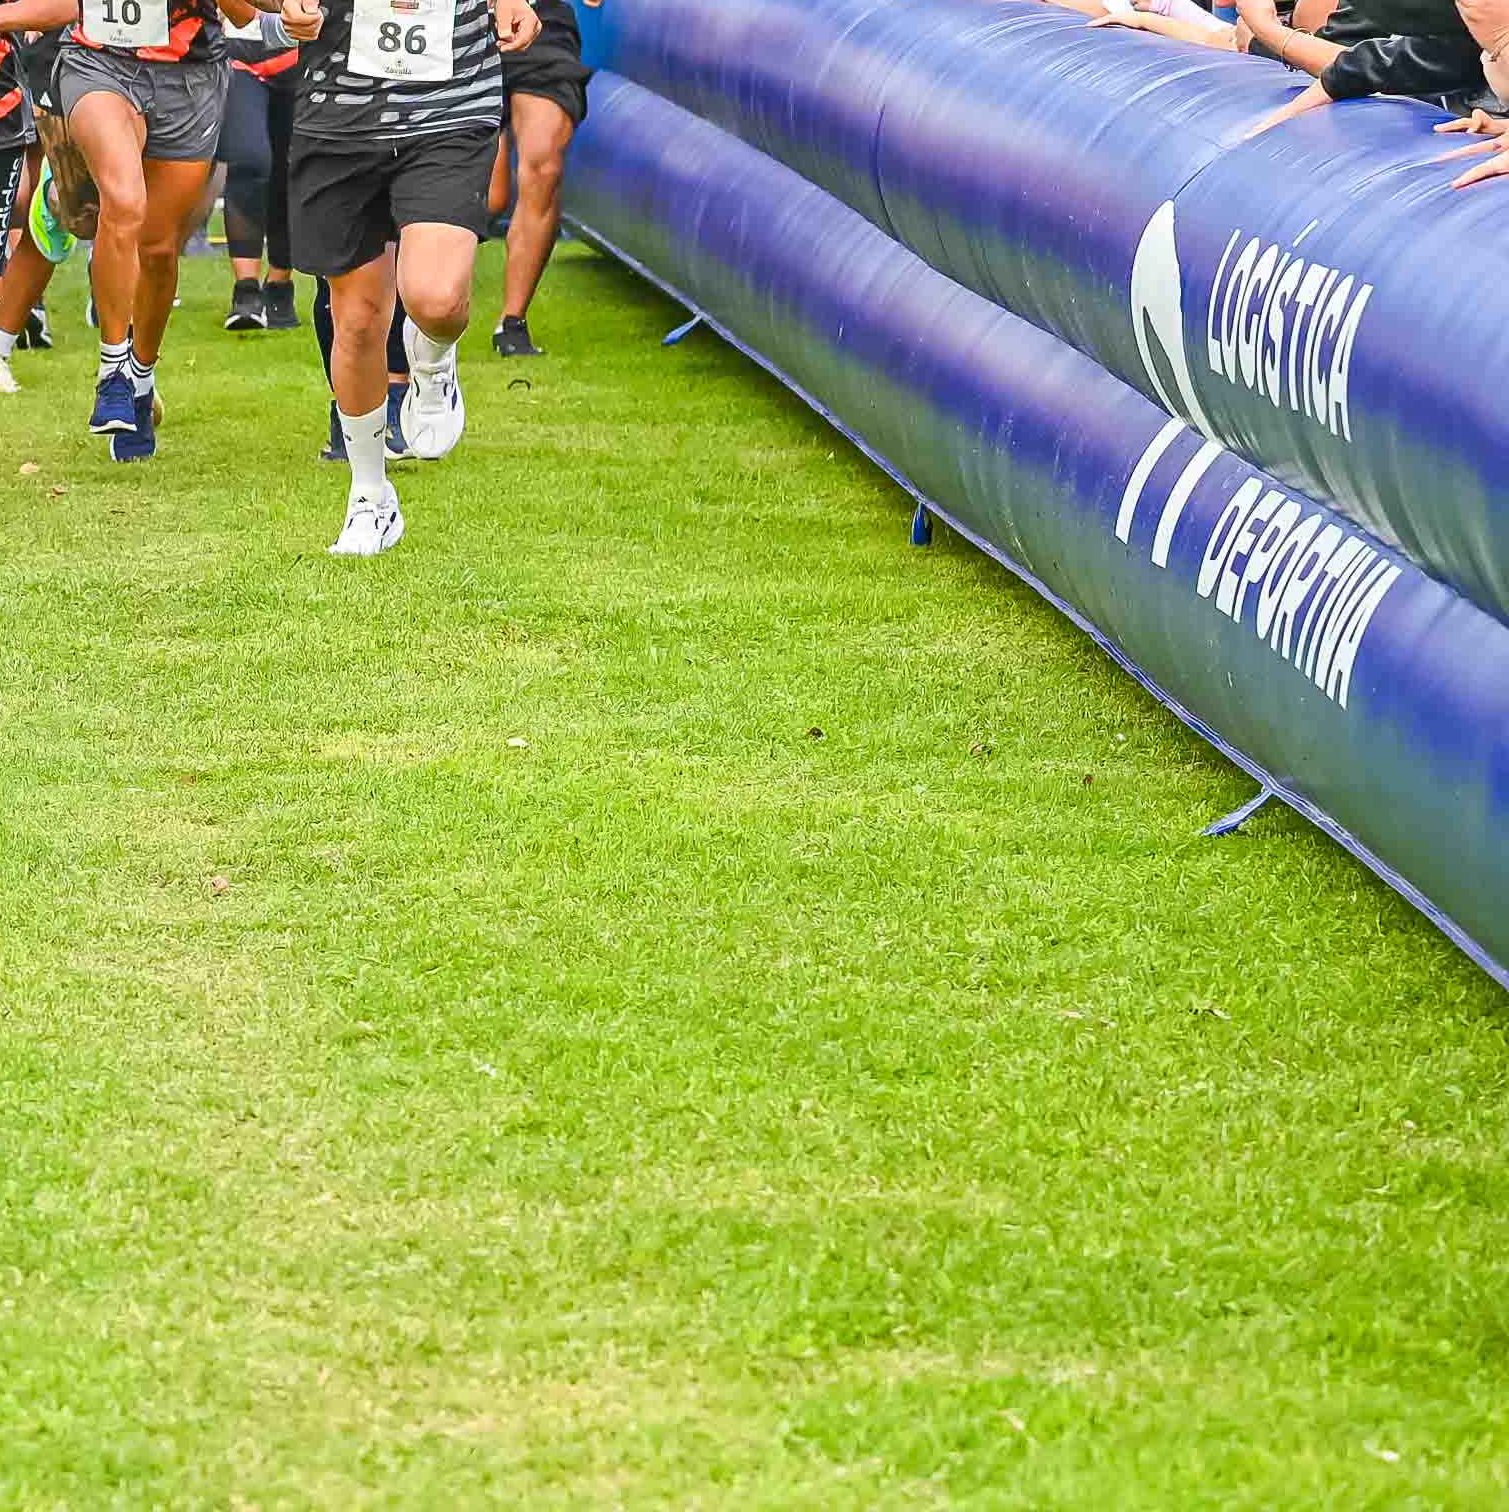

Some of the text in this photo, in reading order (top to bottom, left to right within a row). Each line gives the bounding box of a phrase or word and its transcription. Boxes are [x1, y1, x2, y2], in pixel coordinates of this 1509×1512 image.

[377, 21, 428, 55] 86
[1206, 219, 1374, 442] LOGÍSTICA
[1195, 476, 1404, 712] DEPORTIVA
